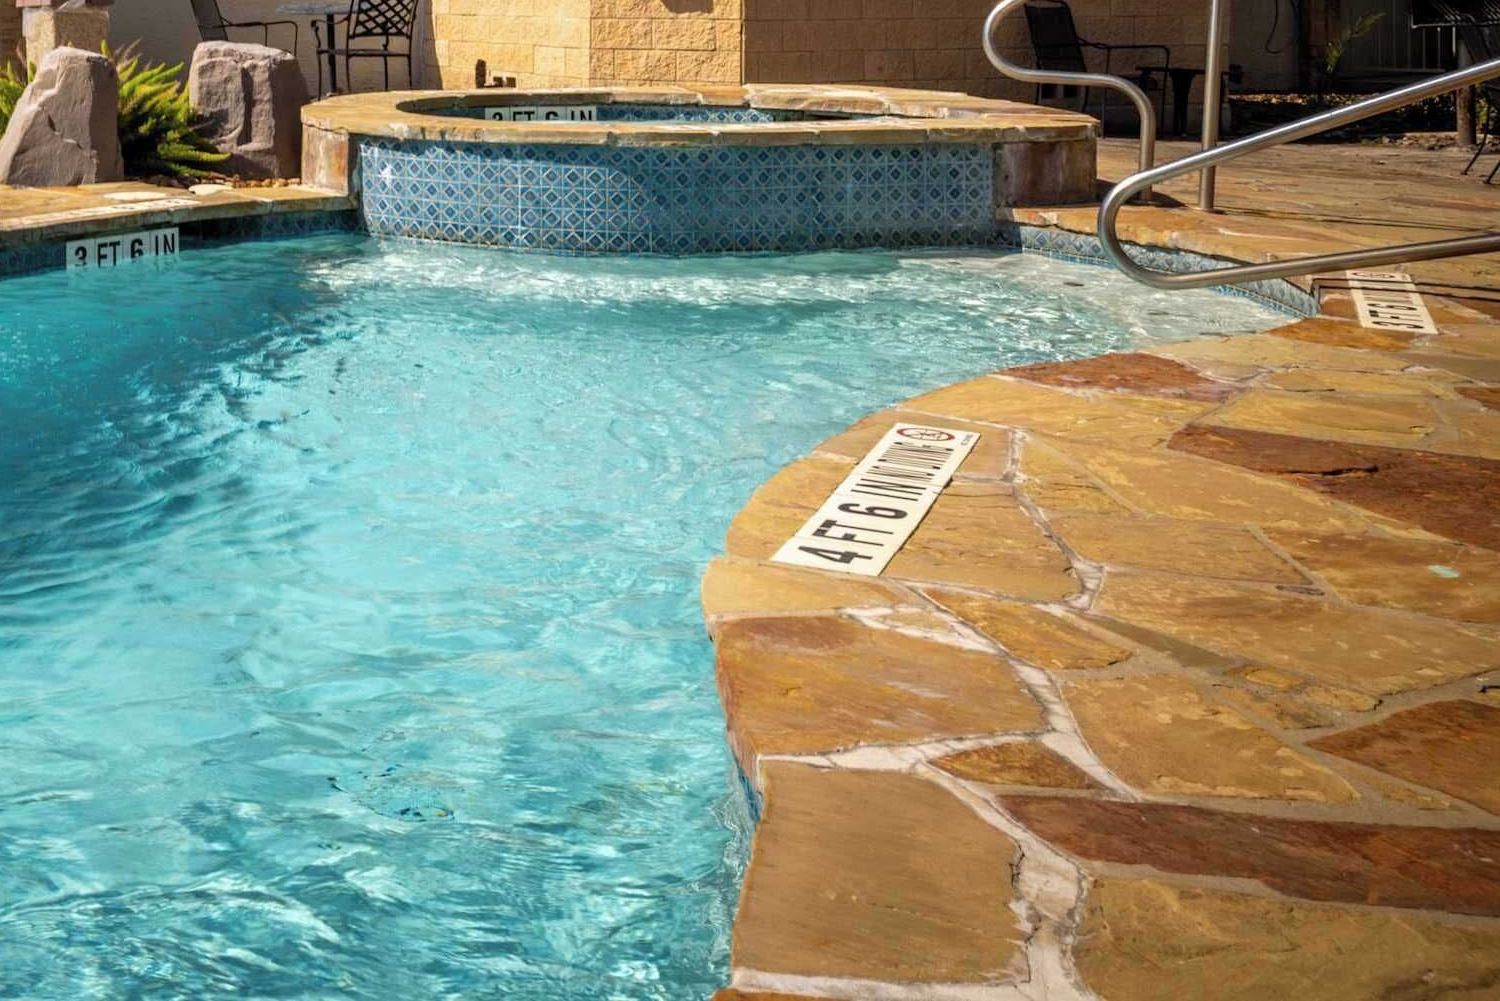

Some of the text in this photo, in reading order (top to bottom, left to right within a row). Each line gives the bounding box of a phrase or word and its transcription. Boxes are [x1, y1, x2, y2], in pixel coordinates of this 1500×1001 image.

[74, 246, 87, 266] 3
[97, 240, 120, 268] FT
[155, 233, 175, 256] IN
[851, 478, 927, 501] IN
[837, 502, 908, 520] 6
[812, 519, 894, 546] FT
[798, 545, 873, 564] 4
